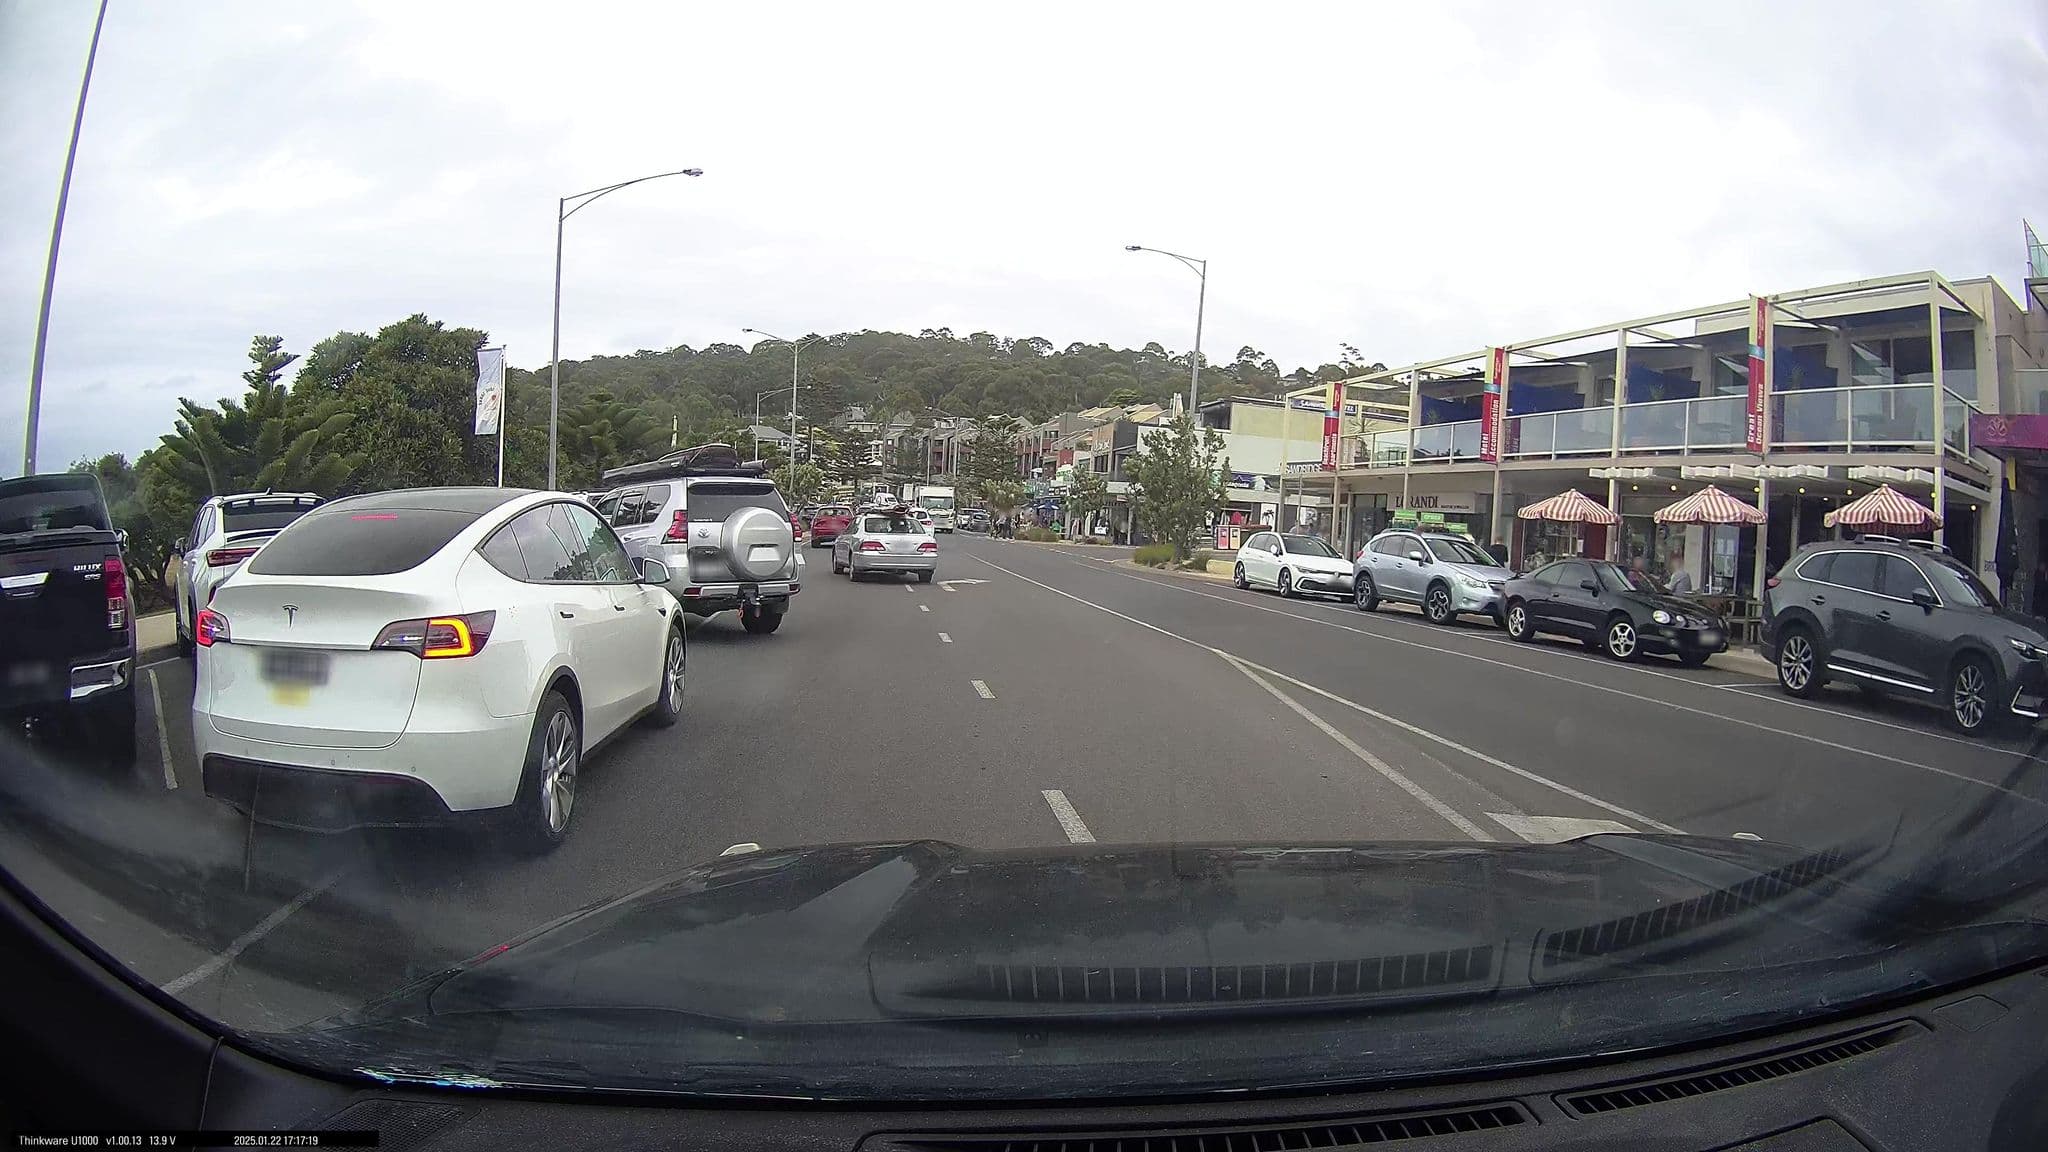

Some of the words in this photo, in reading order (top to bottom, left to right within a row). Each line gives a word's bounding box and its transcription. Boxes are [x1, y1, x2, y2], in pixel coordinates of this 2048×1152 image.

[1756, 383, 1764, 413] Views
[1489, 399, 1499, 457] Accommodation
[1747, 414, 1755, 443] Great
[1480, 433, 1489, 455] Motel
